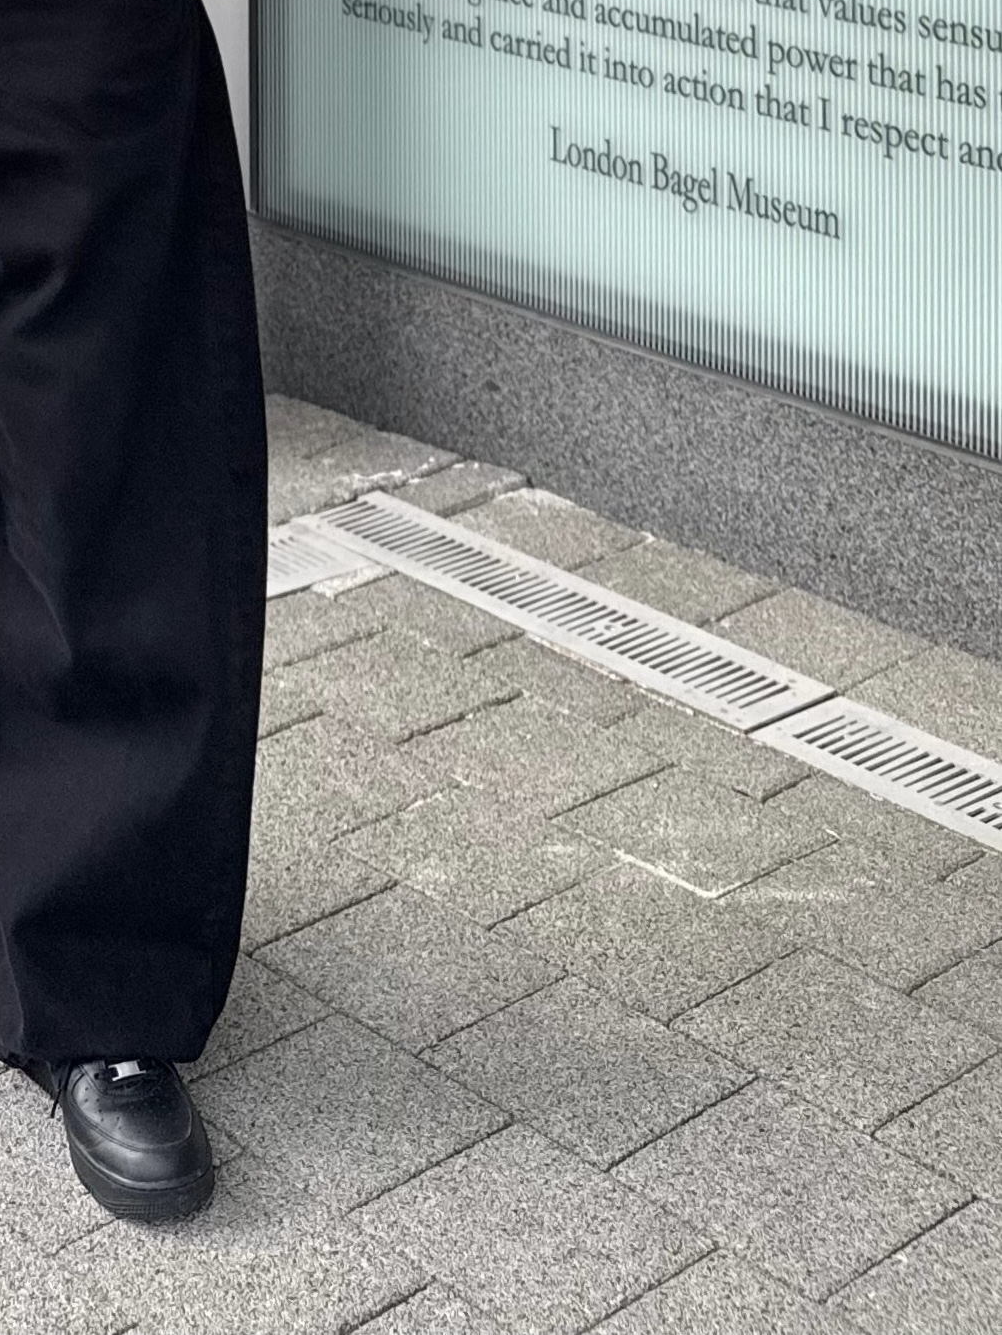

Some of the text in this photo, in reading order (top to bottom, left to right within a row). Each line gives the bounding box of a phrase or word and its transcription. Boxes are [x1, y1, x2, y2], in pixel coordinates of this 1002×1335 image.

[442, 16, 483, 48] and
[490, 30, 571, 69] carried
[579, 41, 597, 76] it
[603, 46, 654, 89] into
[663, 69, 745, 111] action
[755, 83, 810, 126] that
[818, 97, 831, 132] I
[841, 112, 949, 161] respect
[595, 2, 758, 59] accumulated
[767, 39, 858, 81] power
[867, 52, 926, 97] that
[936, 64, 987, 109] has
[549, 125, 841, 240] London Bagel Museum
